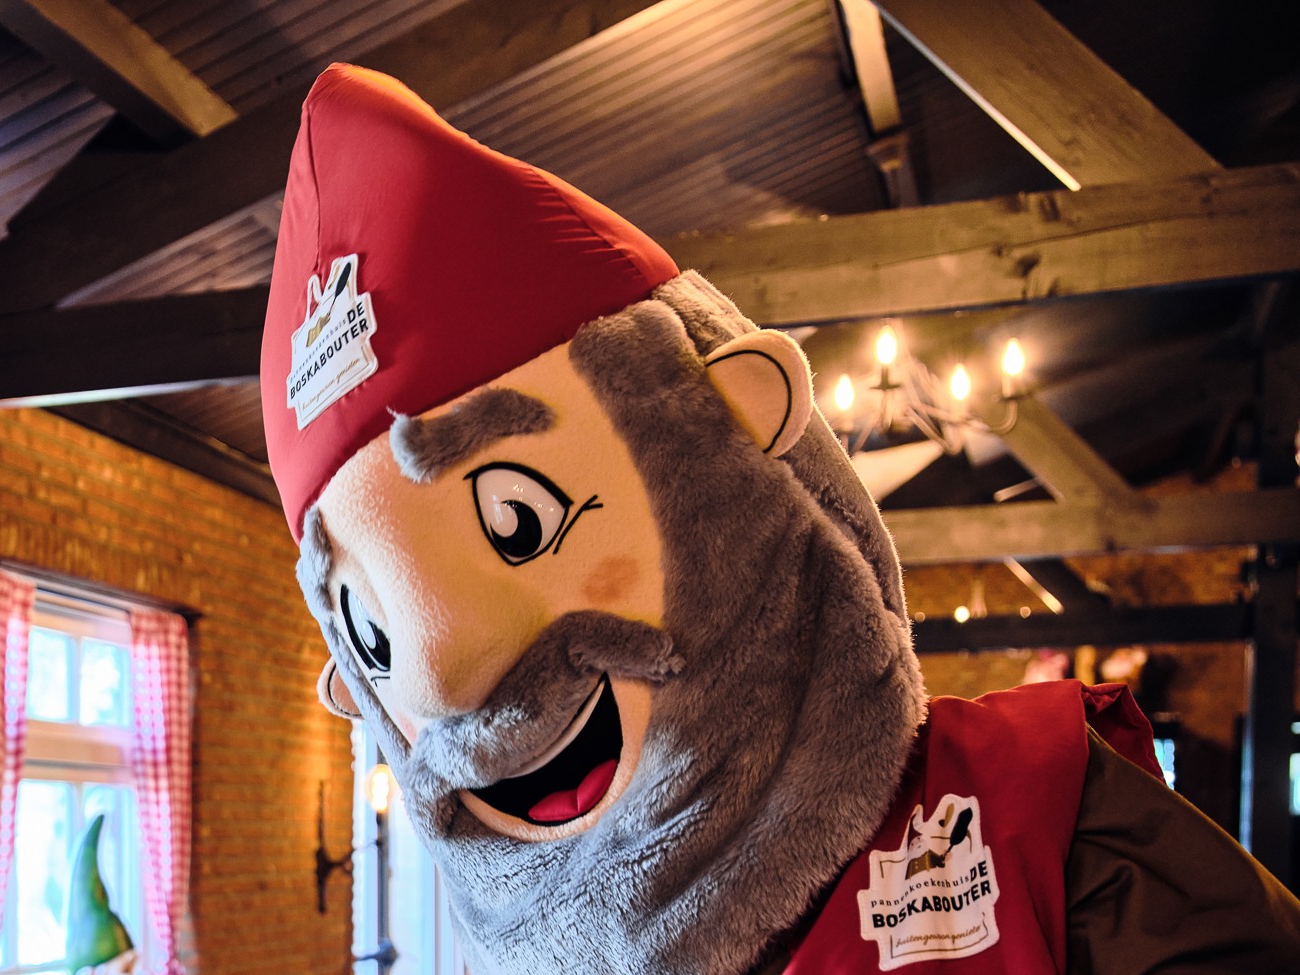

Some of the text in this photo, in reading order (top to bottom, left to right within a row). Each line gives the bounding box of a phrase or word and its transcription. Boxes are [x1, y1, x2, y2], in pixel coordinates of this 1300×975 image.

[347, 302, 365, 325] DE
[290, 318, 369, 399] BOSKABOUTER
[970, 861, 988, 882] DE
[872, 880, 992, 928] BOSKABOUTER
